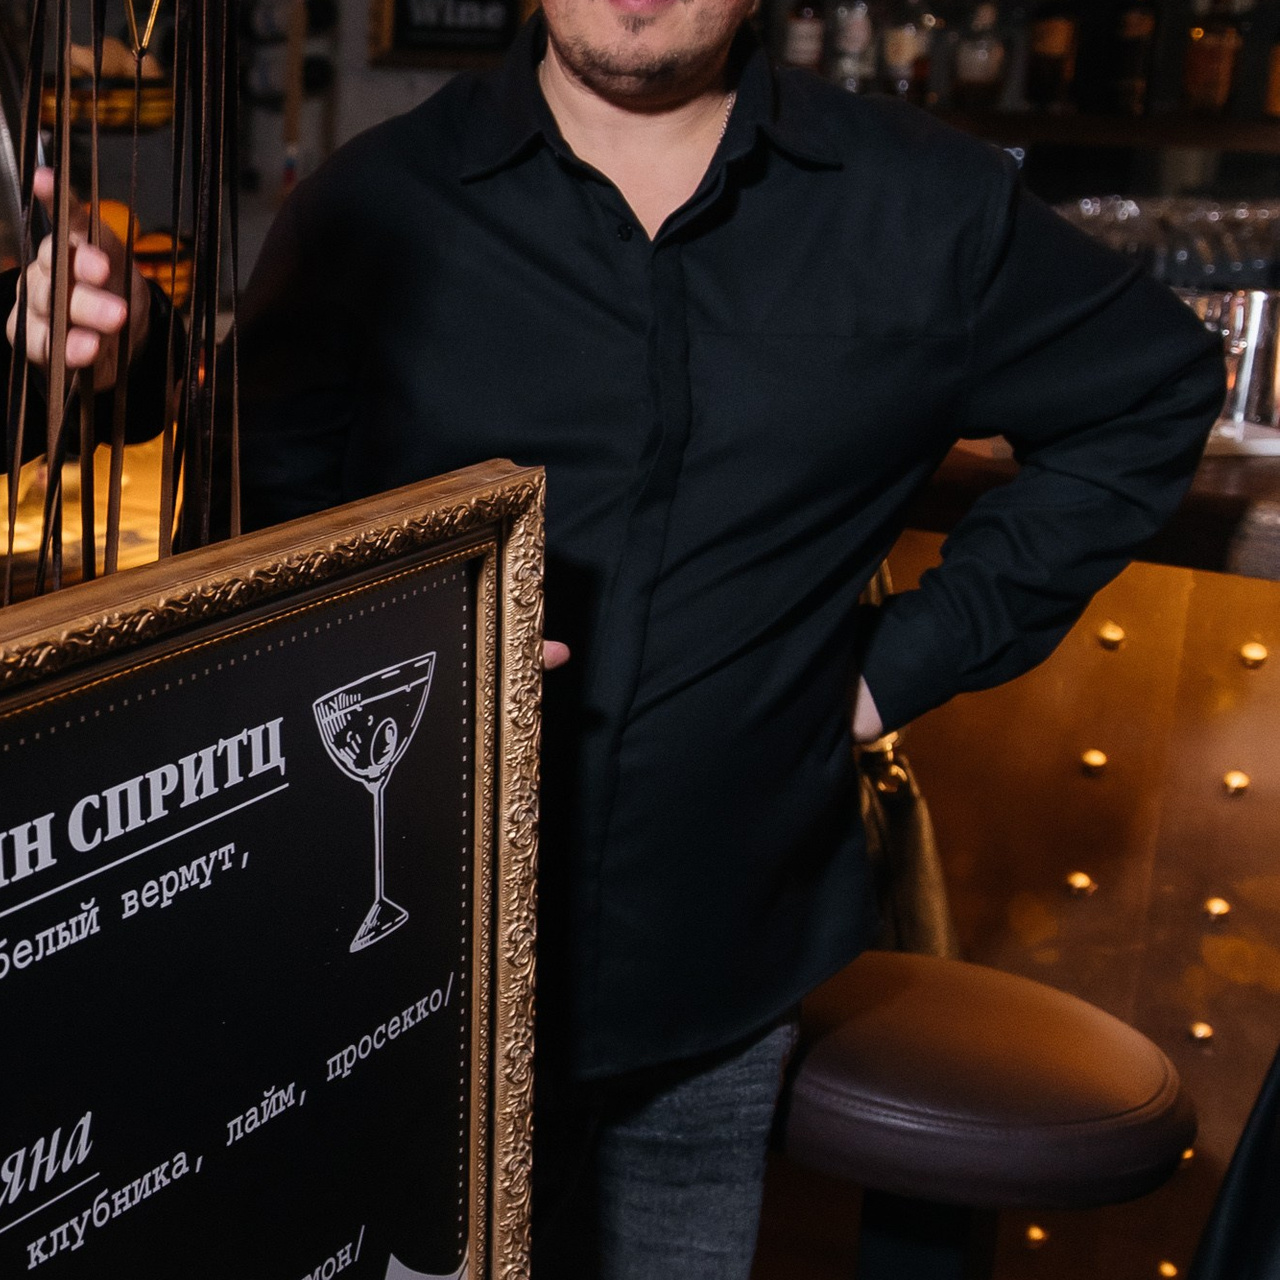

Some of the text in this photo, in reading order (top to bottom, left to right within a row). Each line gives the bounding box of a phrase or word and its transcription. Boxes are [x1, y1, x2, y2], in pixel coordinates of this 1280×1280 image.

[67, 717, 286, 853] СПРИТЦ
[121, 838, 251, 920] вермут,
[26, 1151, 204, 1270] клубника,
[225, 1082, 308, 1147] лайм,
[326, 971, 454, 1082] просекко/
